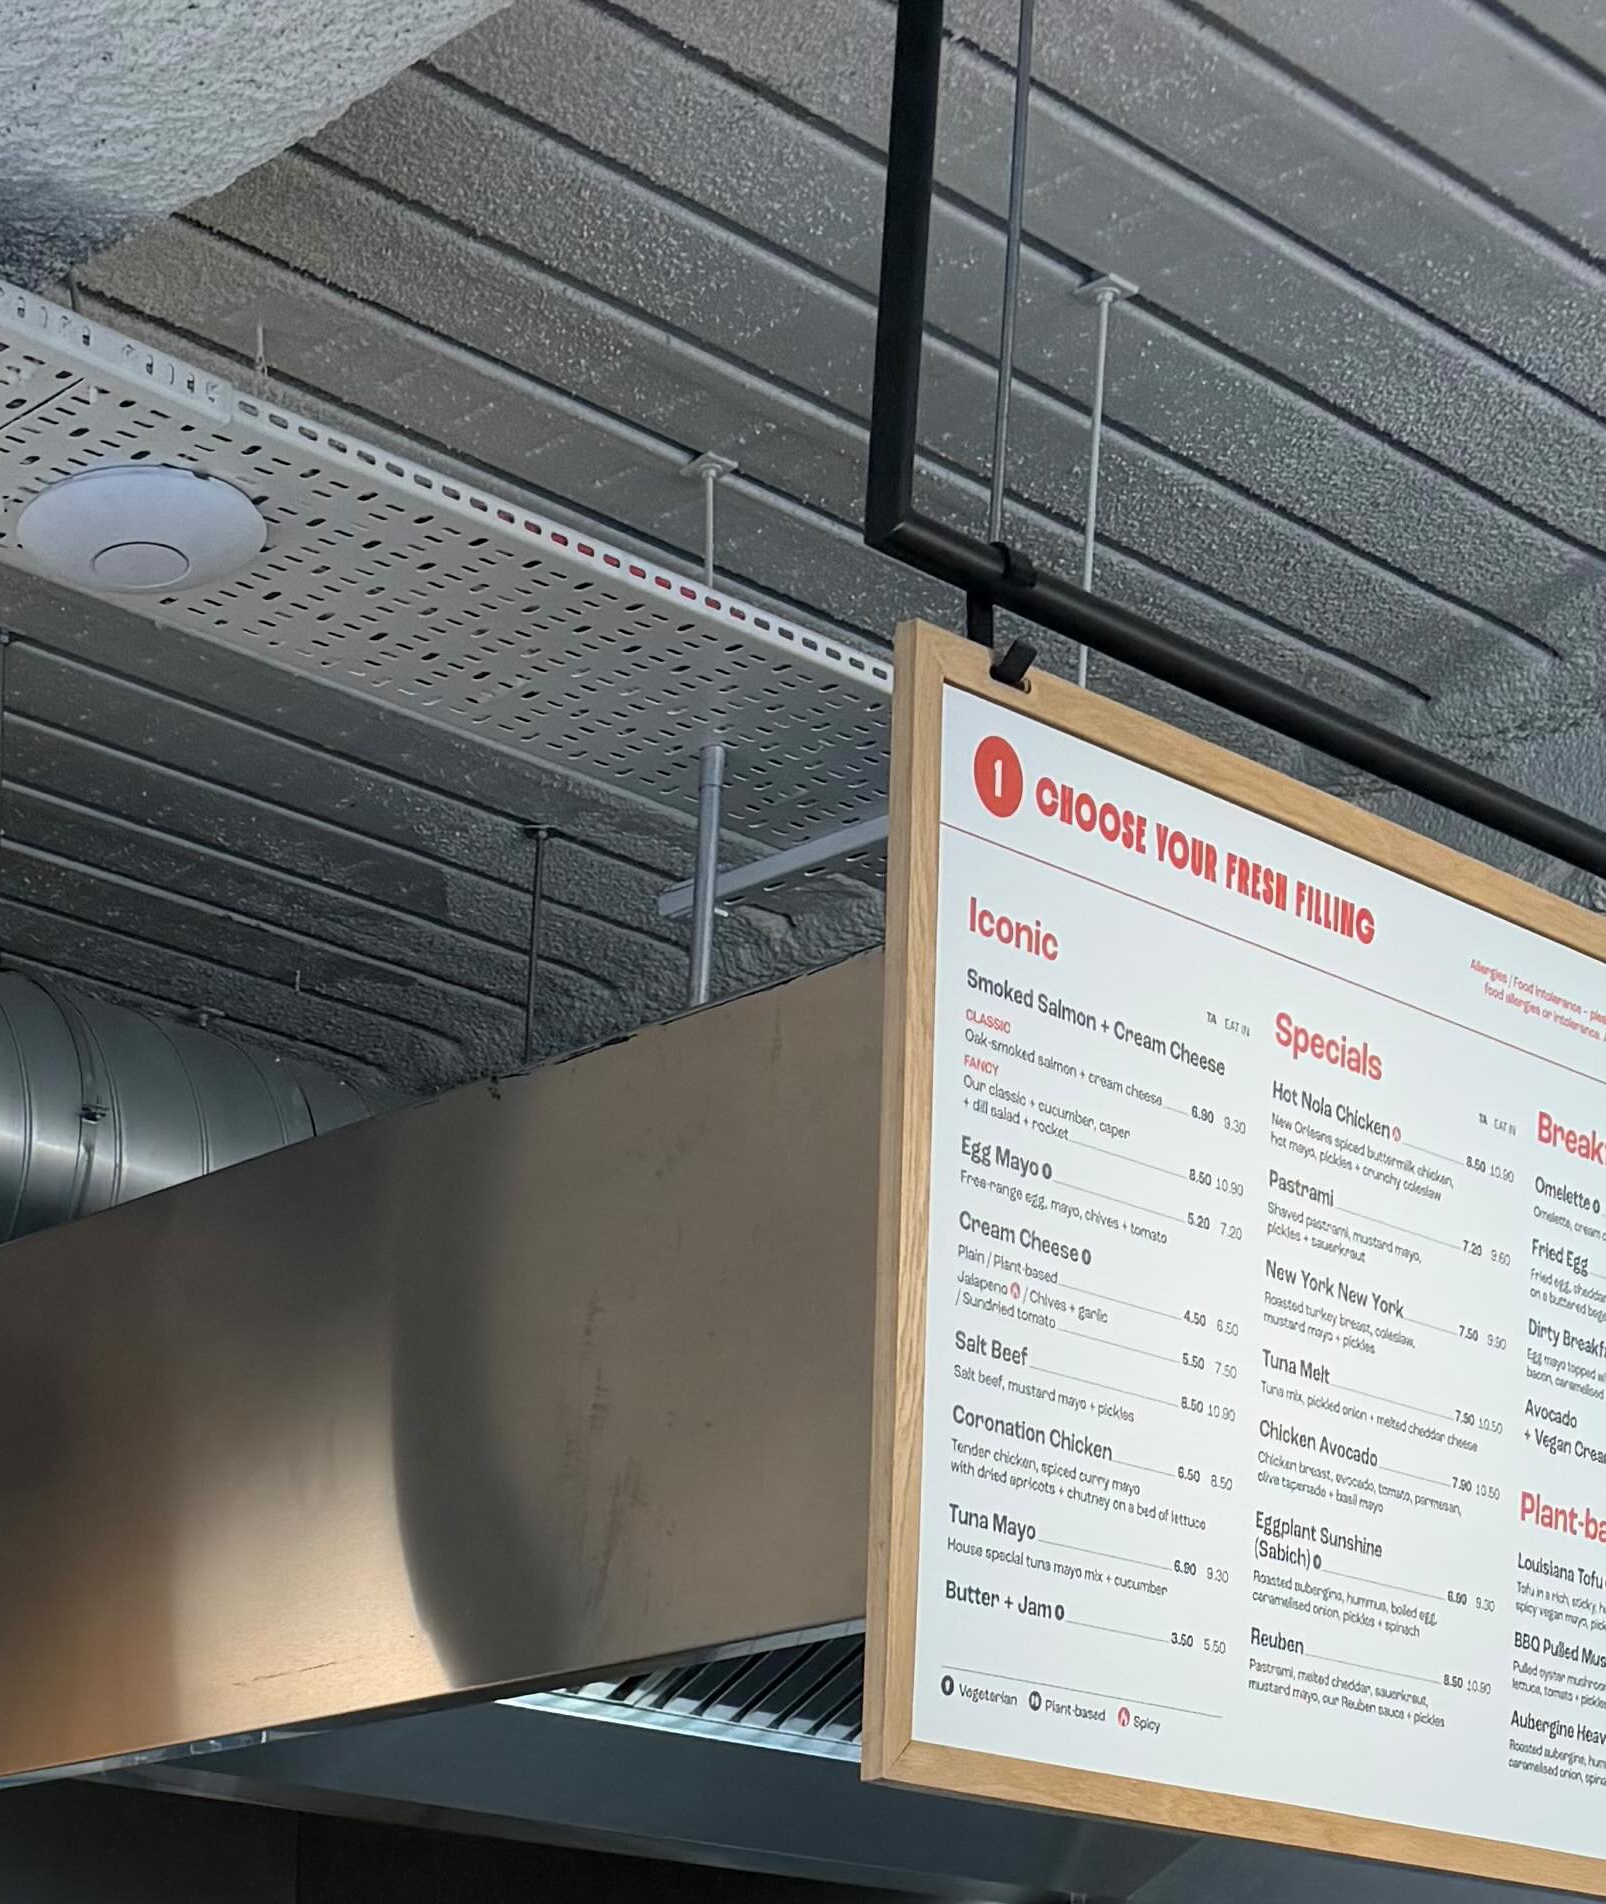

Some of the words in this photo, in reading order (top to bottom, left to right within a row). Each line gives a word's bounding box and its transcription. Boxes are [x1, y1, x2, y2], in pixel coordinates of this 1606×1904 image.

[990, 757, 1004, 799] 1
[1035, 776, 1148, 856] CHOOSE
[1155, 822, 1218, 884] YOUR
[1225, 851, 1288, 912] FRESH
[1294, 879, 1376, 945] FILLING
[969, 895, 1059, 961] Iconic
[965, 1008, 1011, 1035] CLASSIC
[966, 967, 1034, 1009] Smoked
[1037, 992, 1097, 1032] Salmon
[1100, 1019, 1110, 1034] +
[1113, 1020, 1167, 1057] Cream
[1169, 1040, 1226, 1077] Cheese
[963, 1053, 1000, 1078] FANCY
[1274, 1011, 1383, 1081] Specials
[964, 1027, 1036, 1064] Oak-smoked
[1037, 1054, 1078, 1080] salmon
[1078, 1068, 1086, 1081] +
[1087, 1071, 1124, 1095] cream
[1124, 1083, 1163, 1107] cheese
[1272, 1079, 1299, 1107] Hot
[1301, 1089, 1333, 1119] Nola
[1335, 1103, 1391, 1140] Chicken
[1537, 1110, 1606, 1164] Break
[961, 1134, 992, 1168] Egg
[995, 1145, 1040, 1179] Mayo
[1186, 1211, 1211, 1231] 5.20
[1268, 1168, 1335, 1208] Pastrami
[1534, 1175, 1591, 1211] Omelette
[958, 1209, 1016, 1245] Cream
[1019, 1227, 1079, 1263] Cheese
[1531, 1237, 1565, 1265] Fried
[1565, 1248, 1589, 1278] Egg
[957, 1243, 986, 1265] Plain
[992, 1253, 1059, 1286] Plant-based
[1183, 1309, 1207, 1328] 4.50
[1265, 1258, 1297, 1286] New
[1300, 1269, 1335, 1298] York
[1337, 1281, 1369, 1308] New
[1371, 1291, 1405, 1320] York
[1458, 1324, 1479, 1342] 7.50
[955, 1329, 988, 1357] Salt
[990, 1338, 1029, 1367] Beef
[1181, 1352, 1205, 1371] 5.50
[1261, 1348, 1297, 1375] Tuna
[1299, 1359, 1331, 1385] Melt
[1524, 1398, 1578, 1429] Avocado
[952, 1404, 1046, 1446] Coronation
[1049, 1428, 1113, 1462] Chicken
[1177, 1465, 1201, 1484] 6.50
[1259, 1419, 1317, 1452] Chicken
[1318, 1435, 1378, 1468] Avocado
[948, 1502, 989, 1531] Tuna
[992, 1512, 1037, 1543] Mayo
[1255, 1510, 1317, 1543] Eggplant
[1319, 1526, 1383, 1558] Sunshine
[1254, 1536, 1311, 1572] (Sabich)
[1517, 1551, 1575, 1584] Louisiana
[1576, 1566, 1603, 1590] Tofu
[945, 1578, 1000, 1608] Butter
[1003, 1595, 1014, 1610] +
[1017, 1594, 1052, 1620] Jam
[1170, 1631, 1194, 1648] 3.50
[1250, 1626, 1305, 1656] Reuben
[1513, 1630, 1541, 1654] BBQ
[1542, 1637, 1580, 1663] Pulled
[1132, 1715, 1161, 1735] Spicy
[1510, 1709, 1575, 1740] Aubergine
